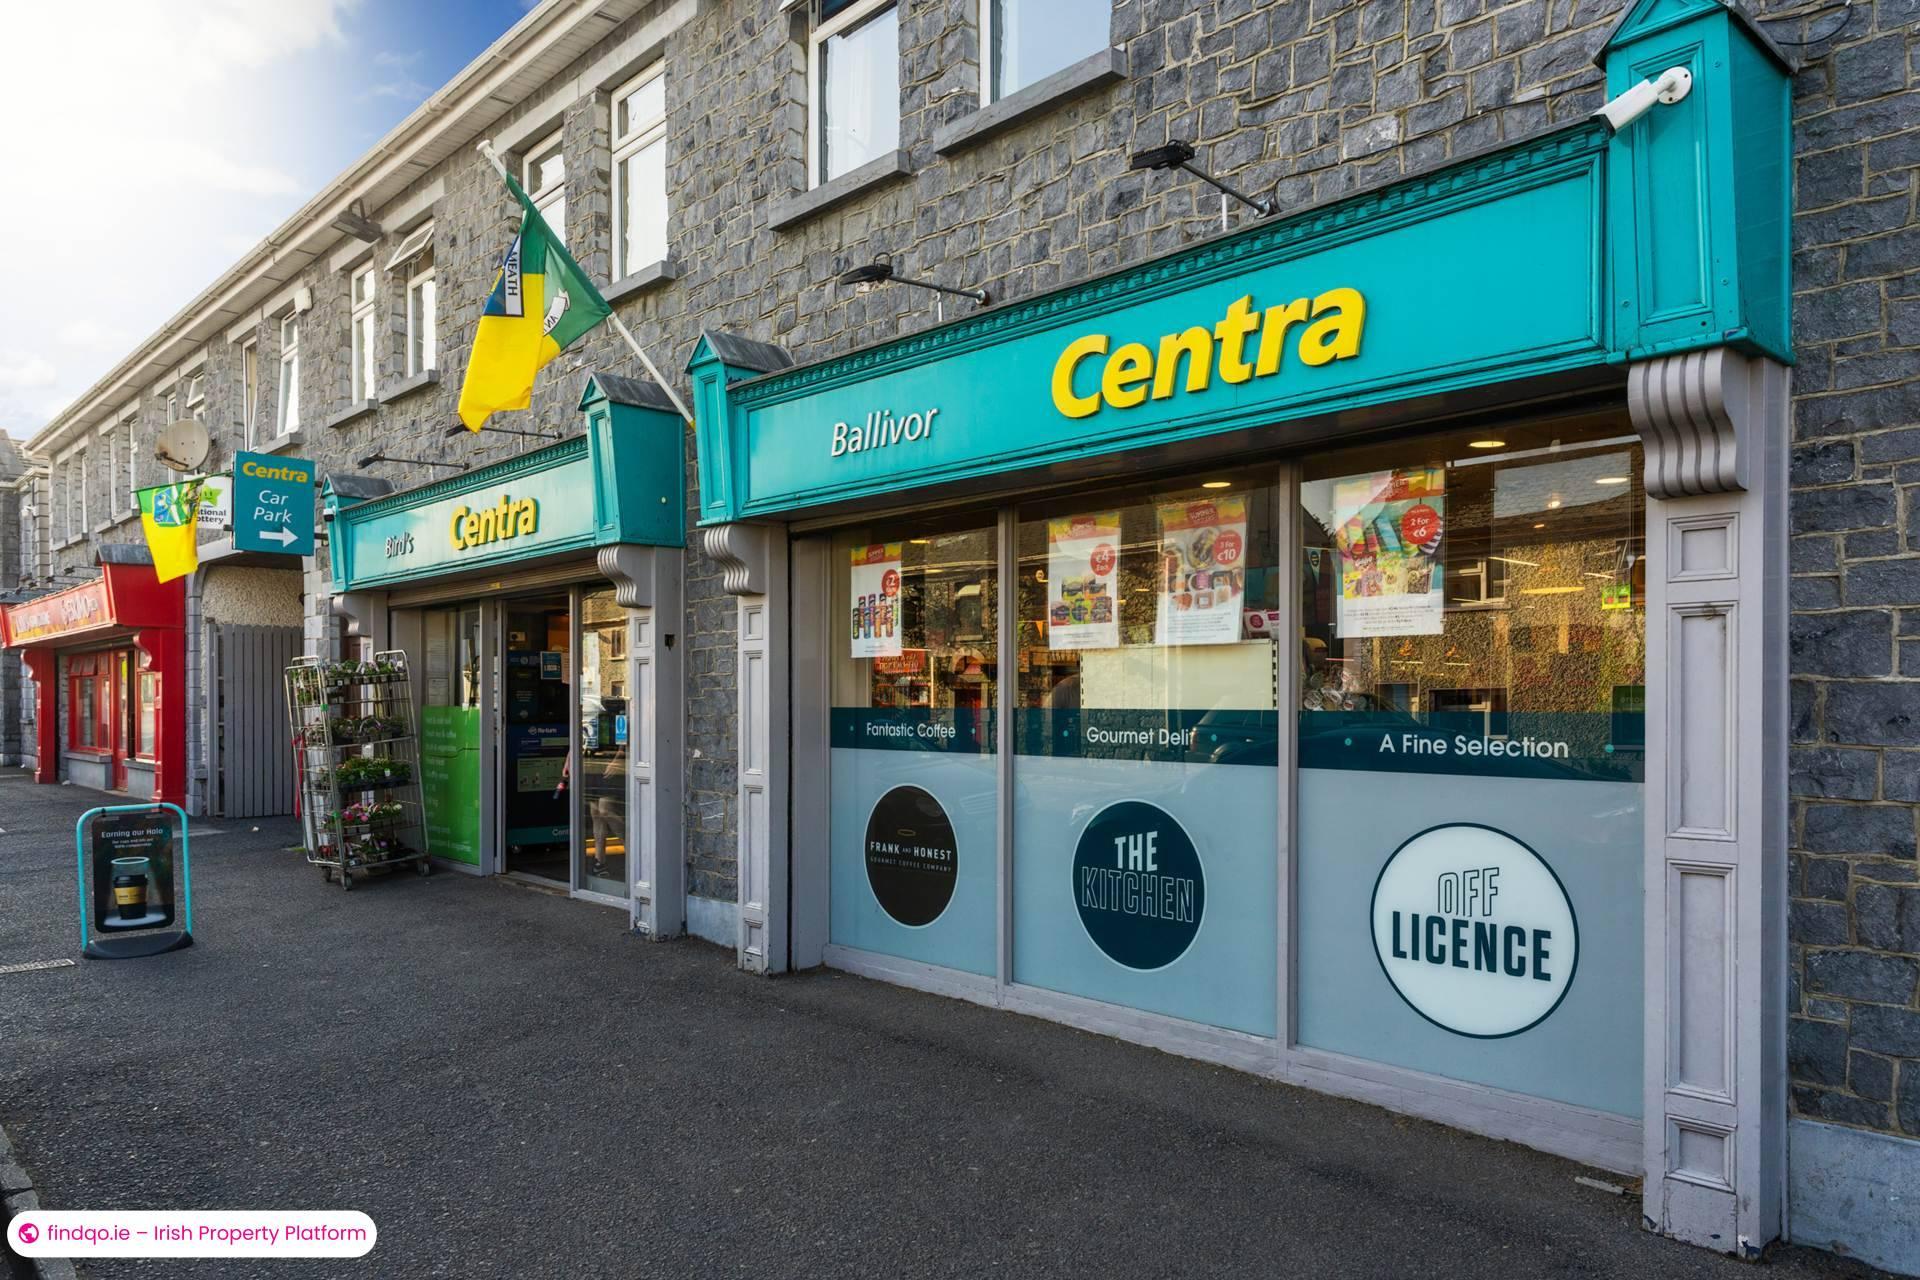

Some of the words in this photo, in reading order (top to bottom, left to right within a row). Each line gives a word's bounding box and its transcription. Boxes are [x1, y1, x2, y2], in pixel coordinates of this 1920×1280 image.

[1050, 286, 1367, 419] Centra
[831, 406, 939, 457] Ballivor
[242, 461, 309, 483] Centra
[258, 490, 289, 505] Car
[198, 515, 224, 524] ottery
[199, 508, 227, 516] tional
[253, 507, 292, 524] Park
[450, 494, 539, 550] Centra
[385, 532, 415, 560] Bird's
[866, 721, 914, 738] Fantastic
[917, 722, 956, 739] Coffee
[1086, 726, 1154, 745] Gourmet
[1379, 733, 1395, 753] A
[1402, 733, 1447, 754] Fine
[1454, 735, 1569, 759] Selection
[101, 830, 130, 838] Earning
[146, 827, 163, 835] Halo
[870, 841, 900, 854] FRANK
[913, 846, 952, 861] HONEST
[1114, 831, 1158, 872] THE
[1082, 866, 1194, 924] KITCHEN
[1437, 866, 1500, 918] OFF
[1392, 910, 1552, 982] LICENCE
